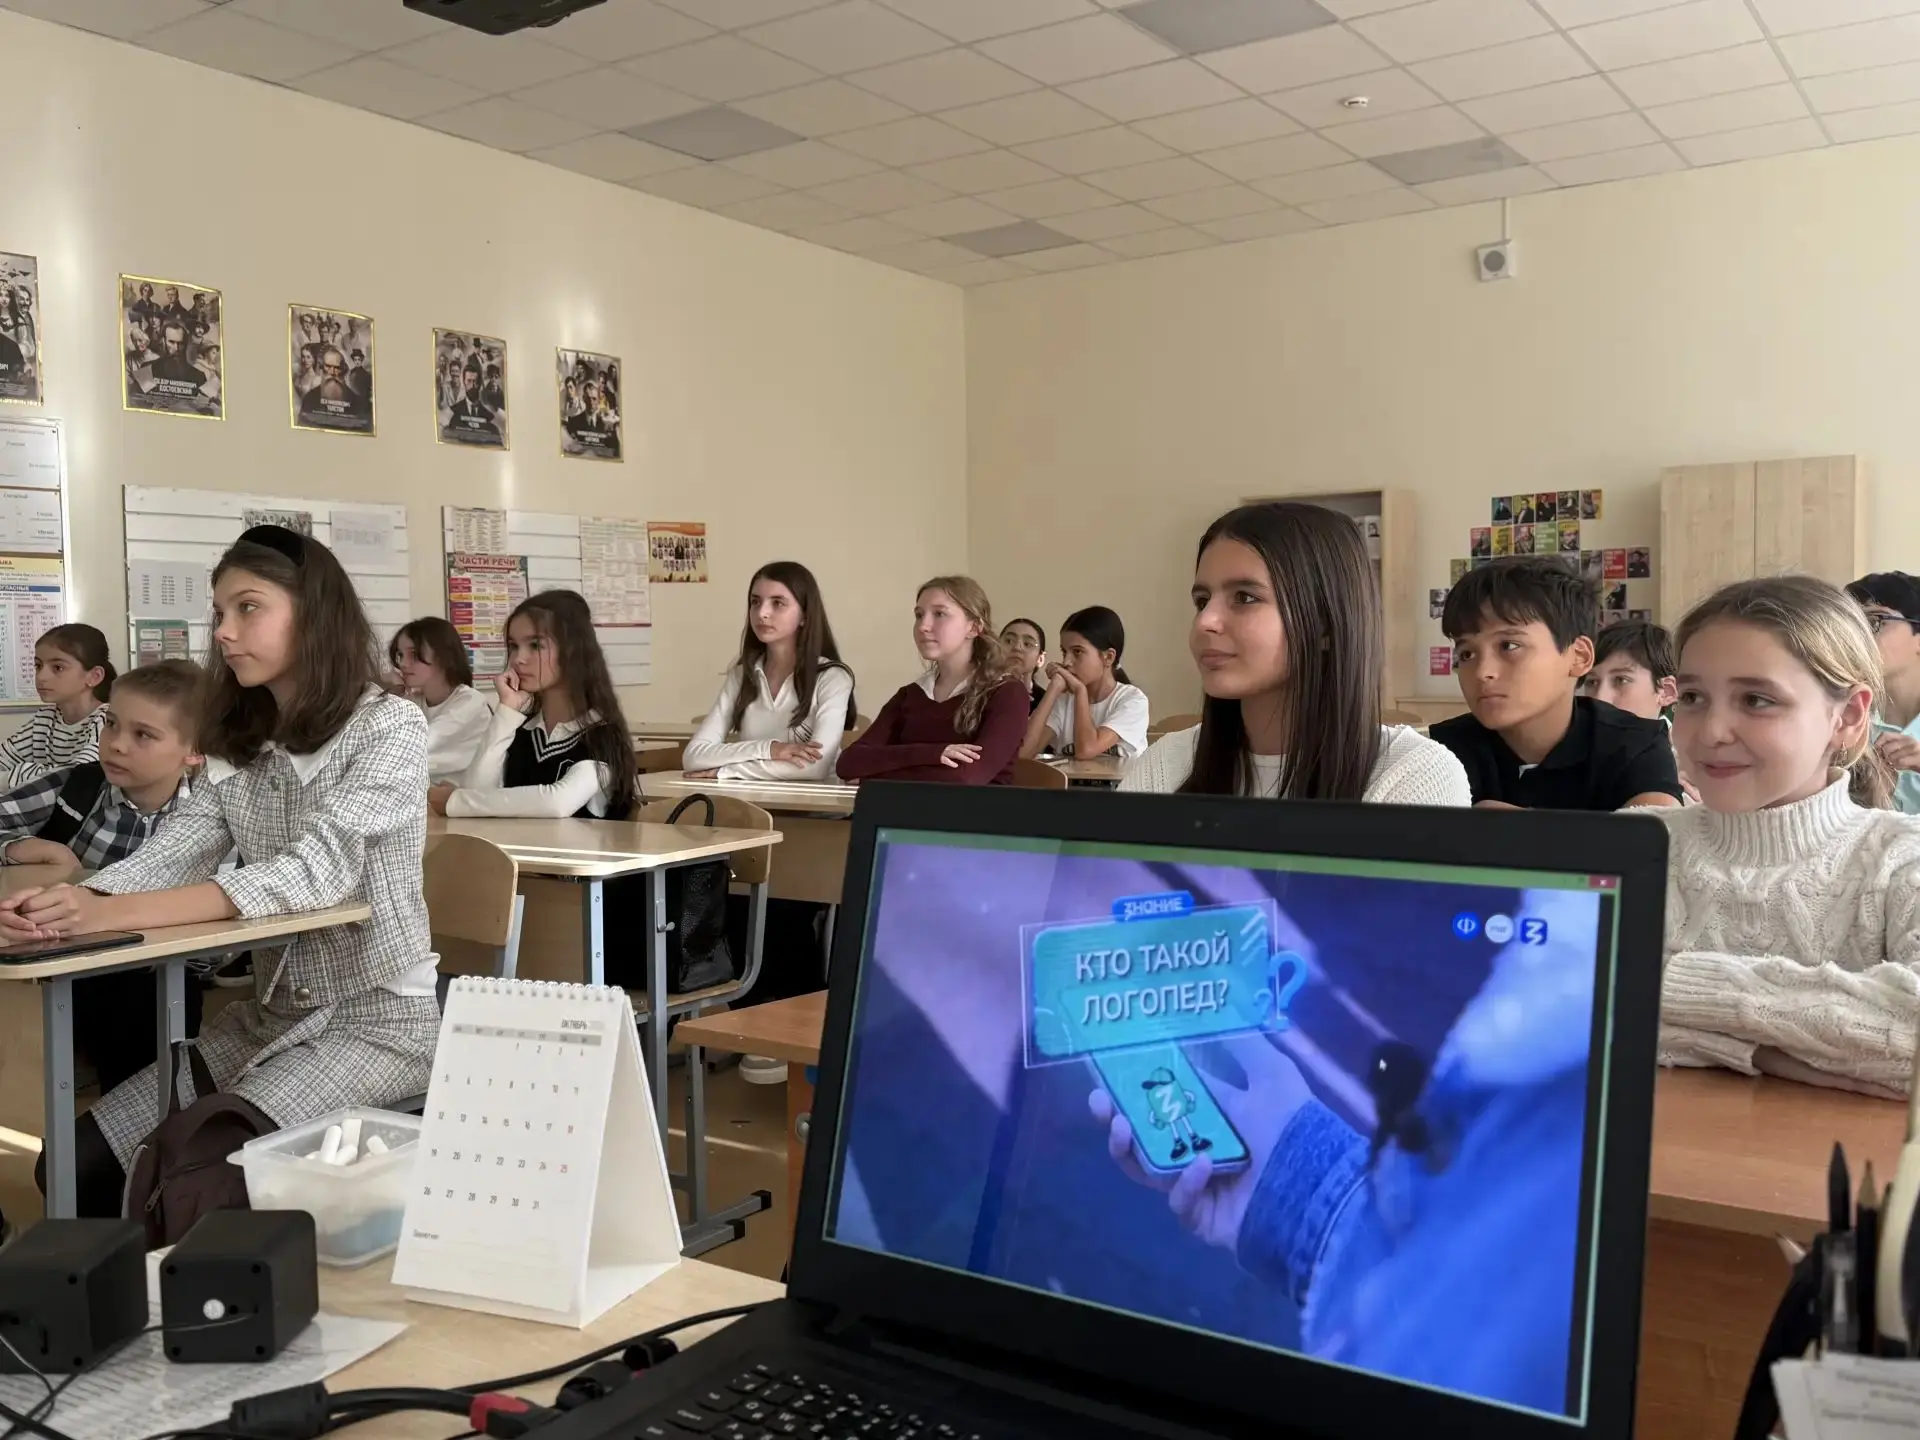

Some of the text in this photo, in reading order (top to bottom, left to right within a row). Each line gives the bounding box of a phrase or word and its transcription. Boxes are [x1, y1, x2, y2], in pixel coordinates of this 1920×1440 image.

[459, 556, 516, 566] ЧАСТИ РЕЧИ
[1075, 929, 1231, 981] КТО ТАКОЙ
[1082, 979, 1229, 1025] ЛОГОПЕД?
[561, 1019, 588, 1029] ОКТЯБРЬ
